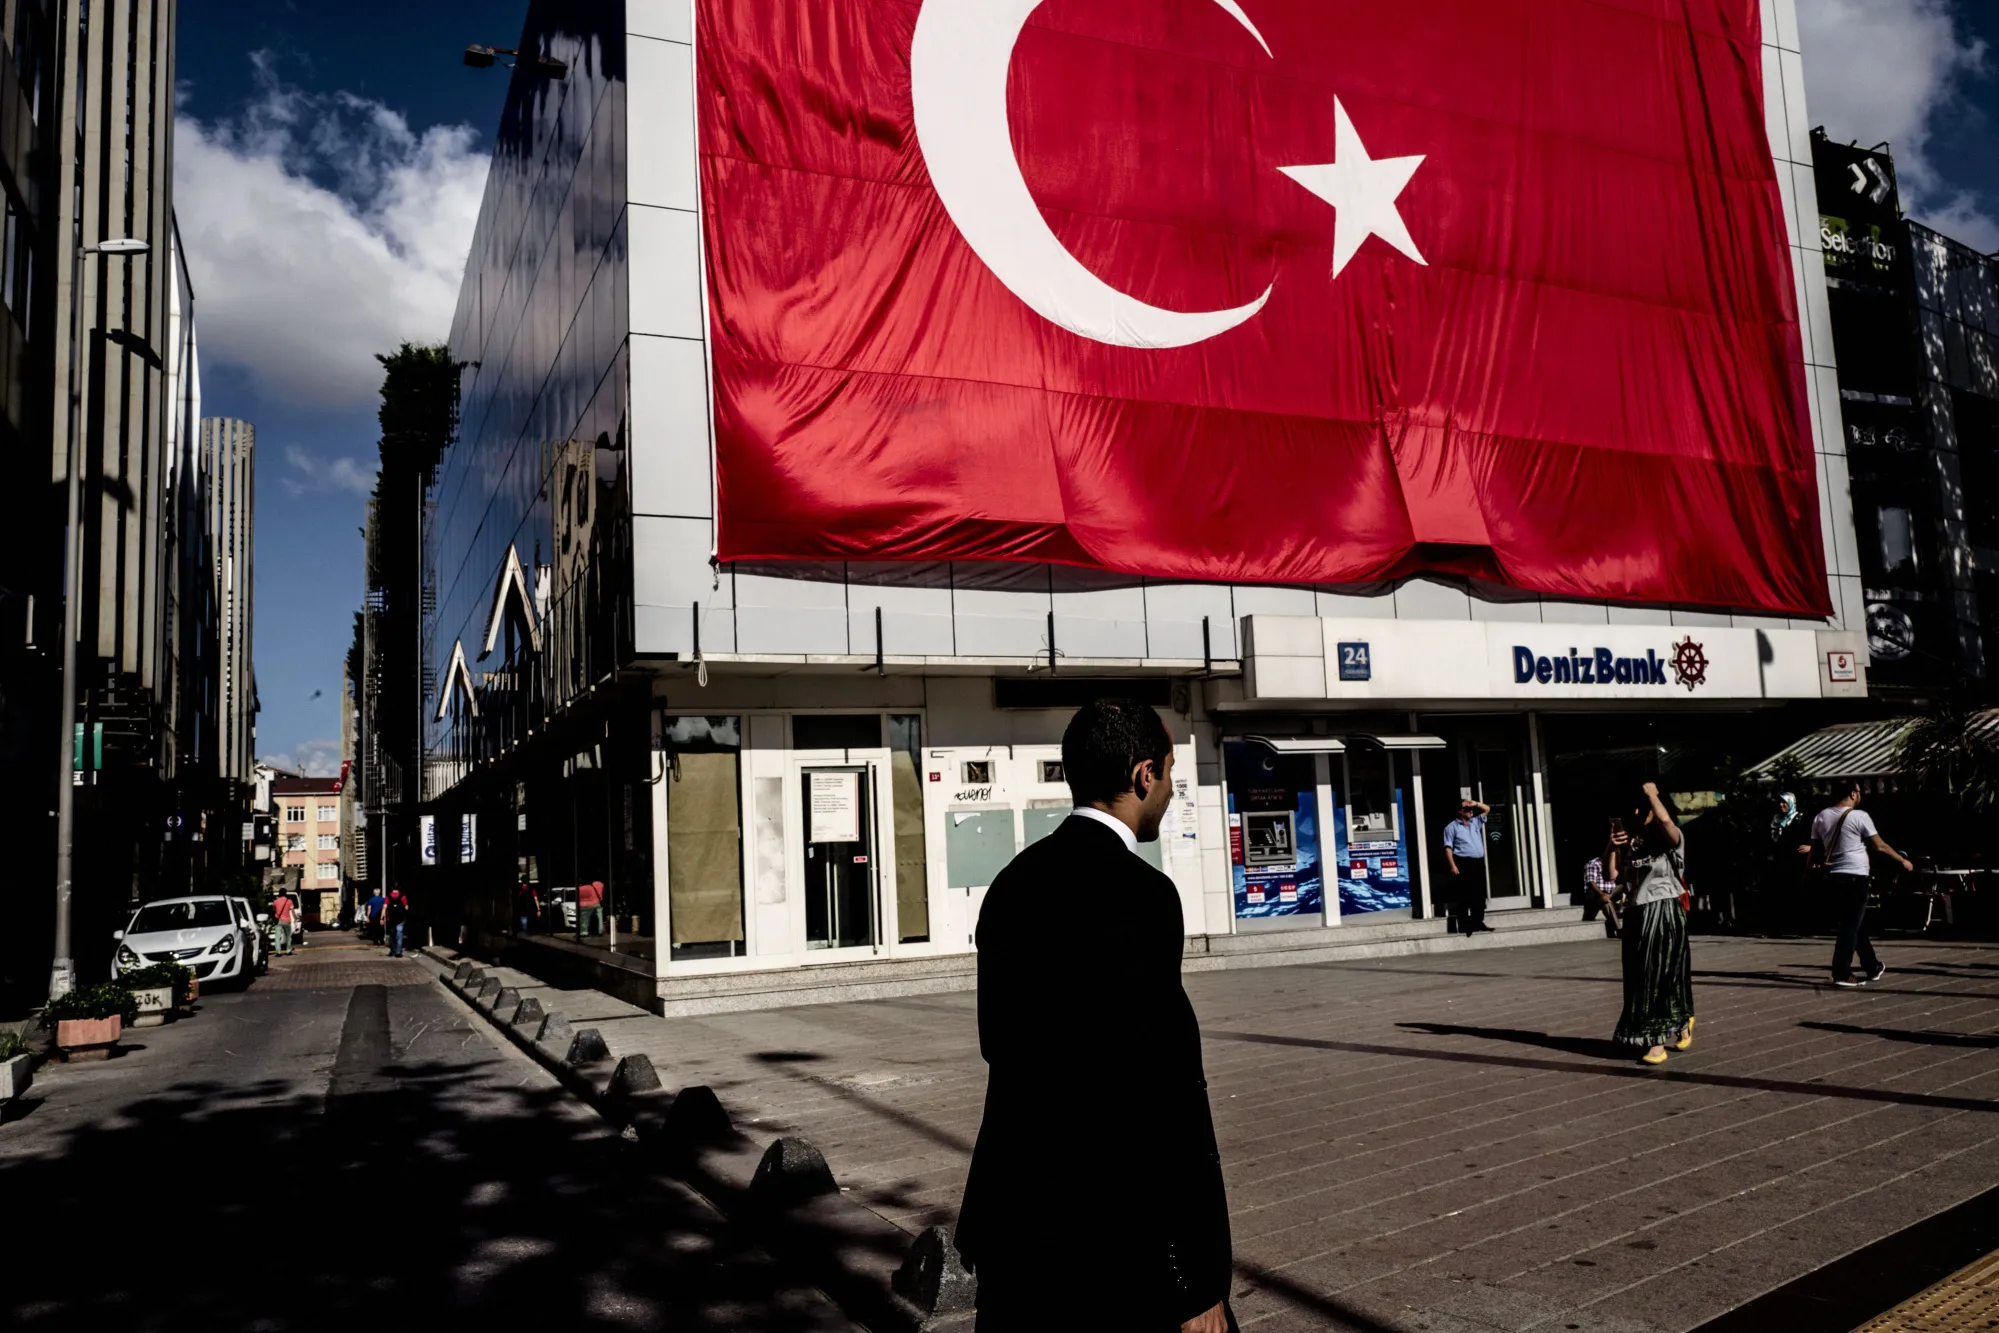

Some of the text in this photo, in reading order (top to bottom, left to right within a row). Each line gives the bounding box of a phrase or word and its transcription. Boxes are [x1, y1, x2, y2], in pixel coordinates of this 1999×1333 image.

[1820, 227, 1898, 261] Selection
[1344, 647, 1368, 665] 24
[1512, 645, 1667, 684] DenizBank
